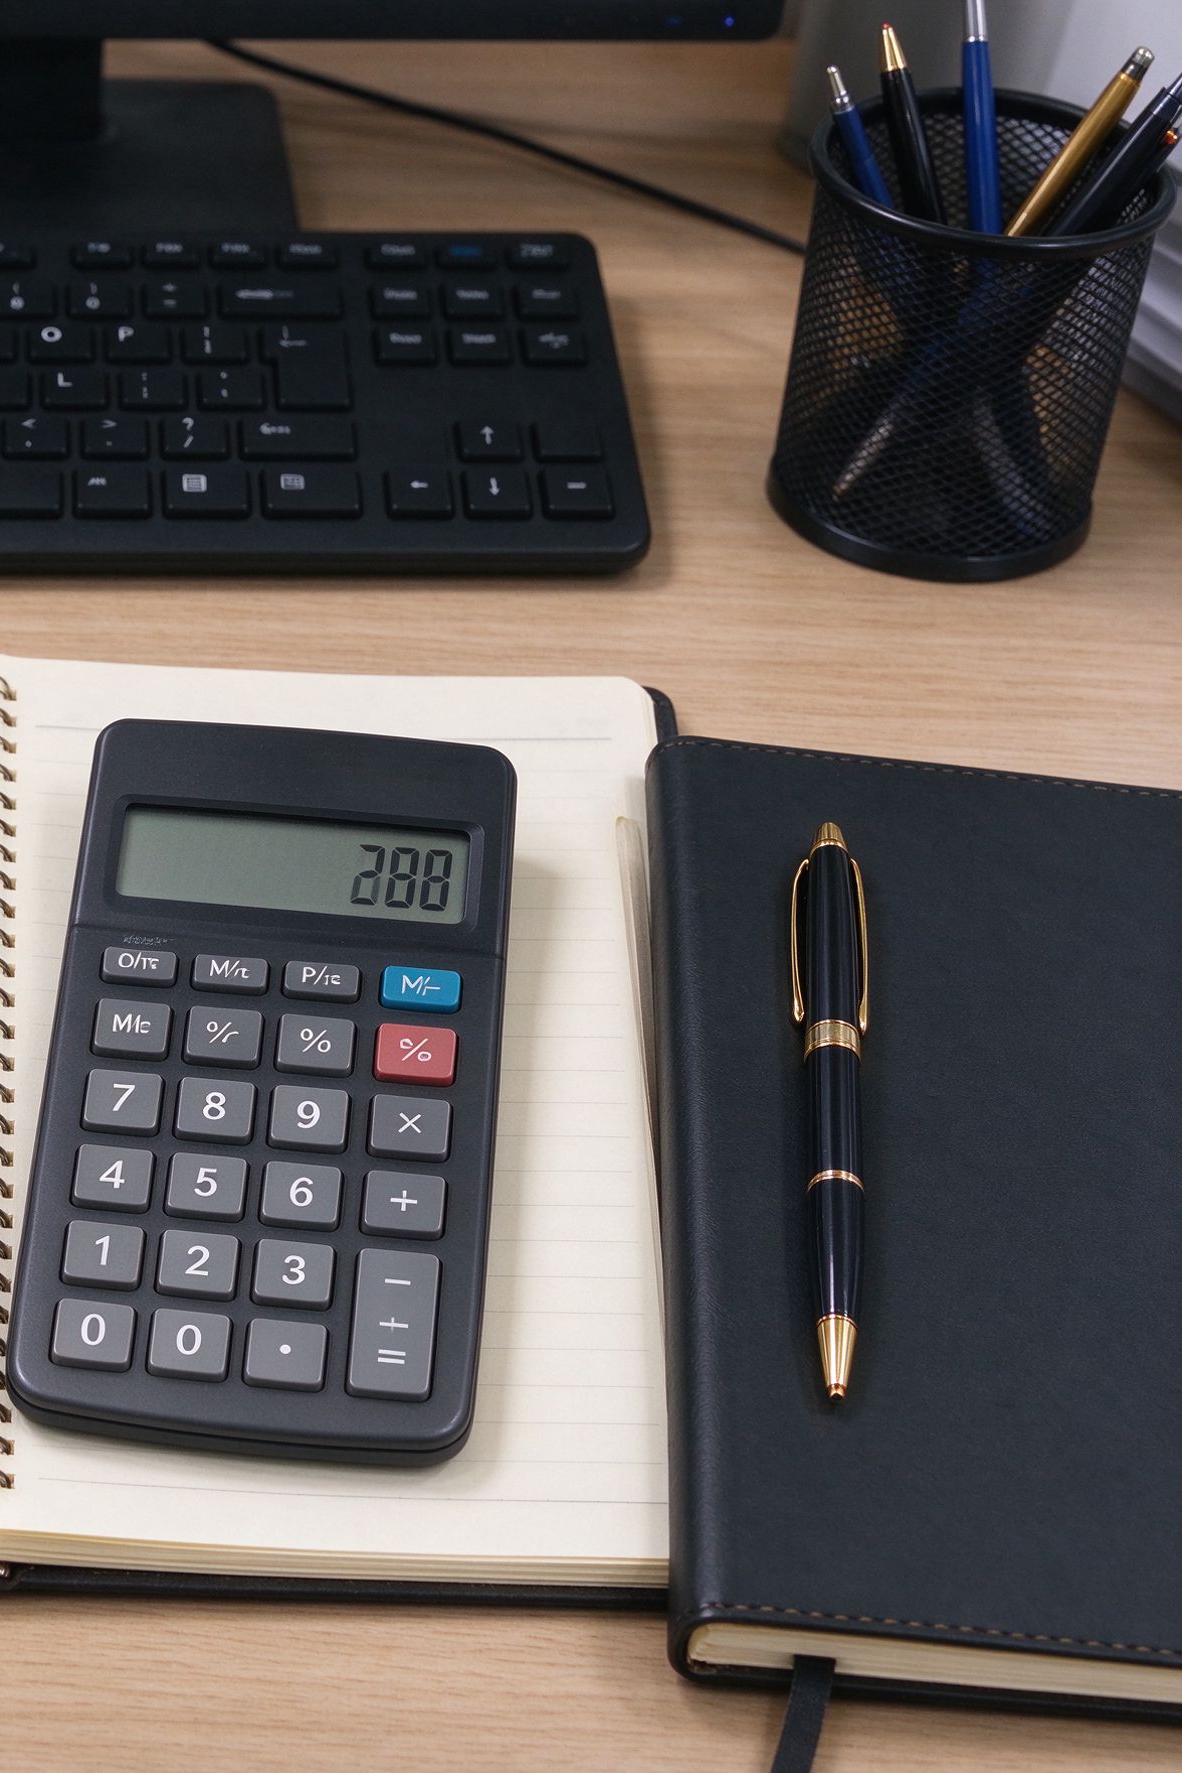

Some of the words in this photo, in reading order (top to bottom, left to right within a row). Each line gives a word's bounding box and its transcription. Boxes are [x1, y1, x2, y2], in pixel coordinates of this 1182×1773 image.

[40, 326, 62, 343] O
[118, 326, 134, 341] P
[57, 372, 72, 387] L
[349, 843, 454, 913] 288
[300, 1028, 332, 1053] %
[112, 1083, 136, 1112] 7
[202, 1091, 226, 1121] 8
[296, 1100, 321, 1129] 9
[99, 1160, 125, 1189] 4
[194, 1167, 218, 1197] 5
[289, 1176, 314, 1207] 6
[390, 1190, 418, 1212] +
[95, 1235, 110, 1266] 1
[184, 1245, 210, 1276] 2
[282, 1255, 306, 1285] 3
[80, 1313, 106, 1346] 0
[176, 1324, 202, 1356] 0
[377, 1348, 407, 1365] =
